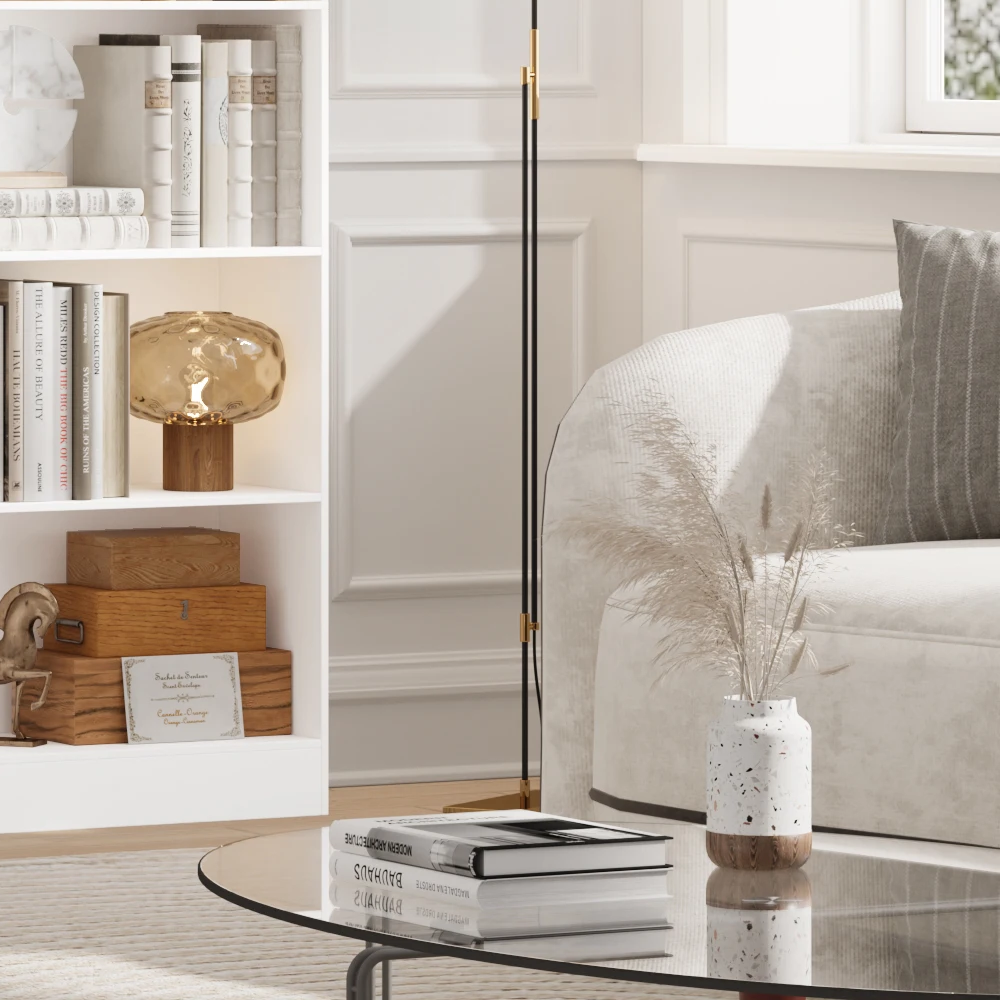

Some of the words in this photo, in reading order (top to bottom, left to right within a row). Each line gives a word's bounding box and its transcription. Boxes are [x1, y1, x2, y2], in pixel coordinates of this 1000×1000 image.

[35, 287, 43, 309] THE
[35, 311, 43, 356] ALLURE
[35, 358, 43, 373] OF
[35, 376, 43, 421] BEAUTY
[83, 434, 90, 446] OF
[60, 447, 67, 461] OF
[345, 833, 388, 852] ARCHITECTURE
[387, 844, 412, 857] MODERN
[354, 863, 403, 889] BAUHAUS
[416, 880, 436, 892] DROSTE
[436, 884, 470, 898] MAGDALENA
